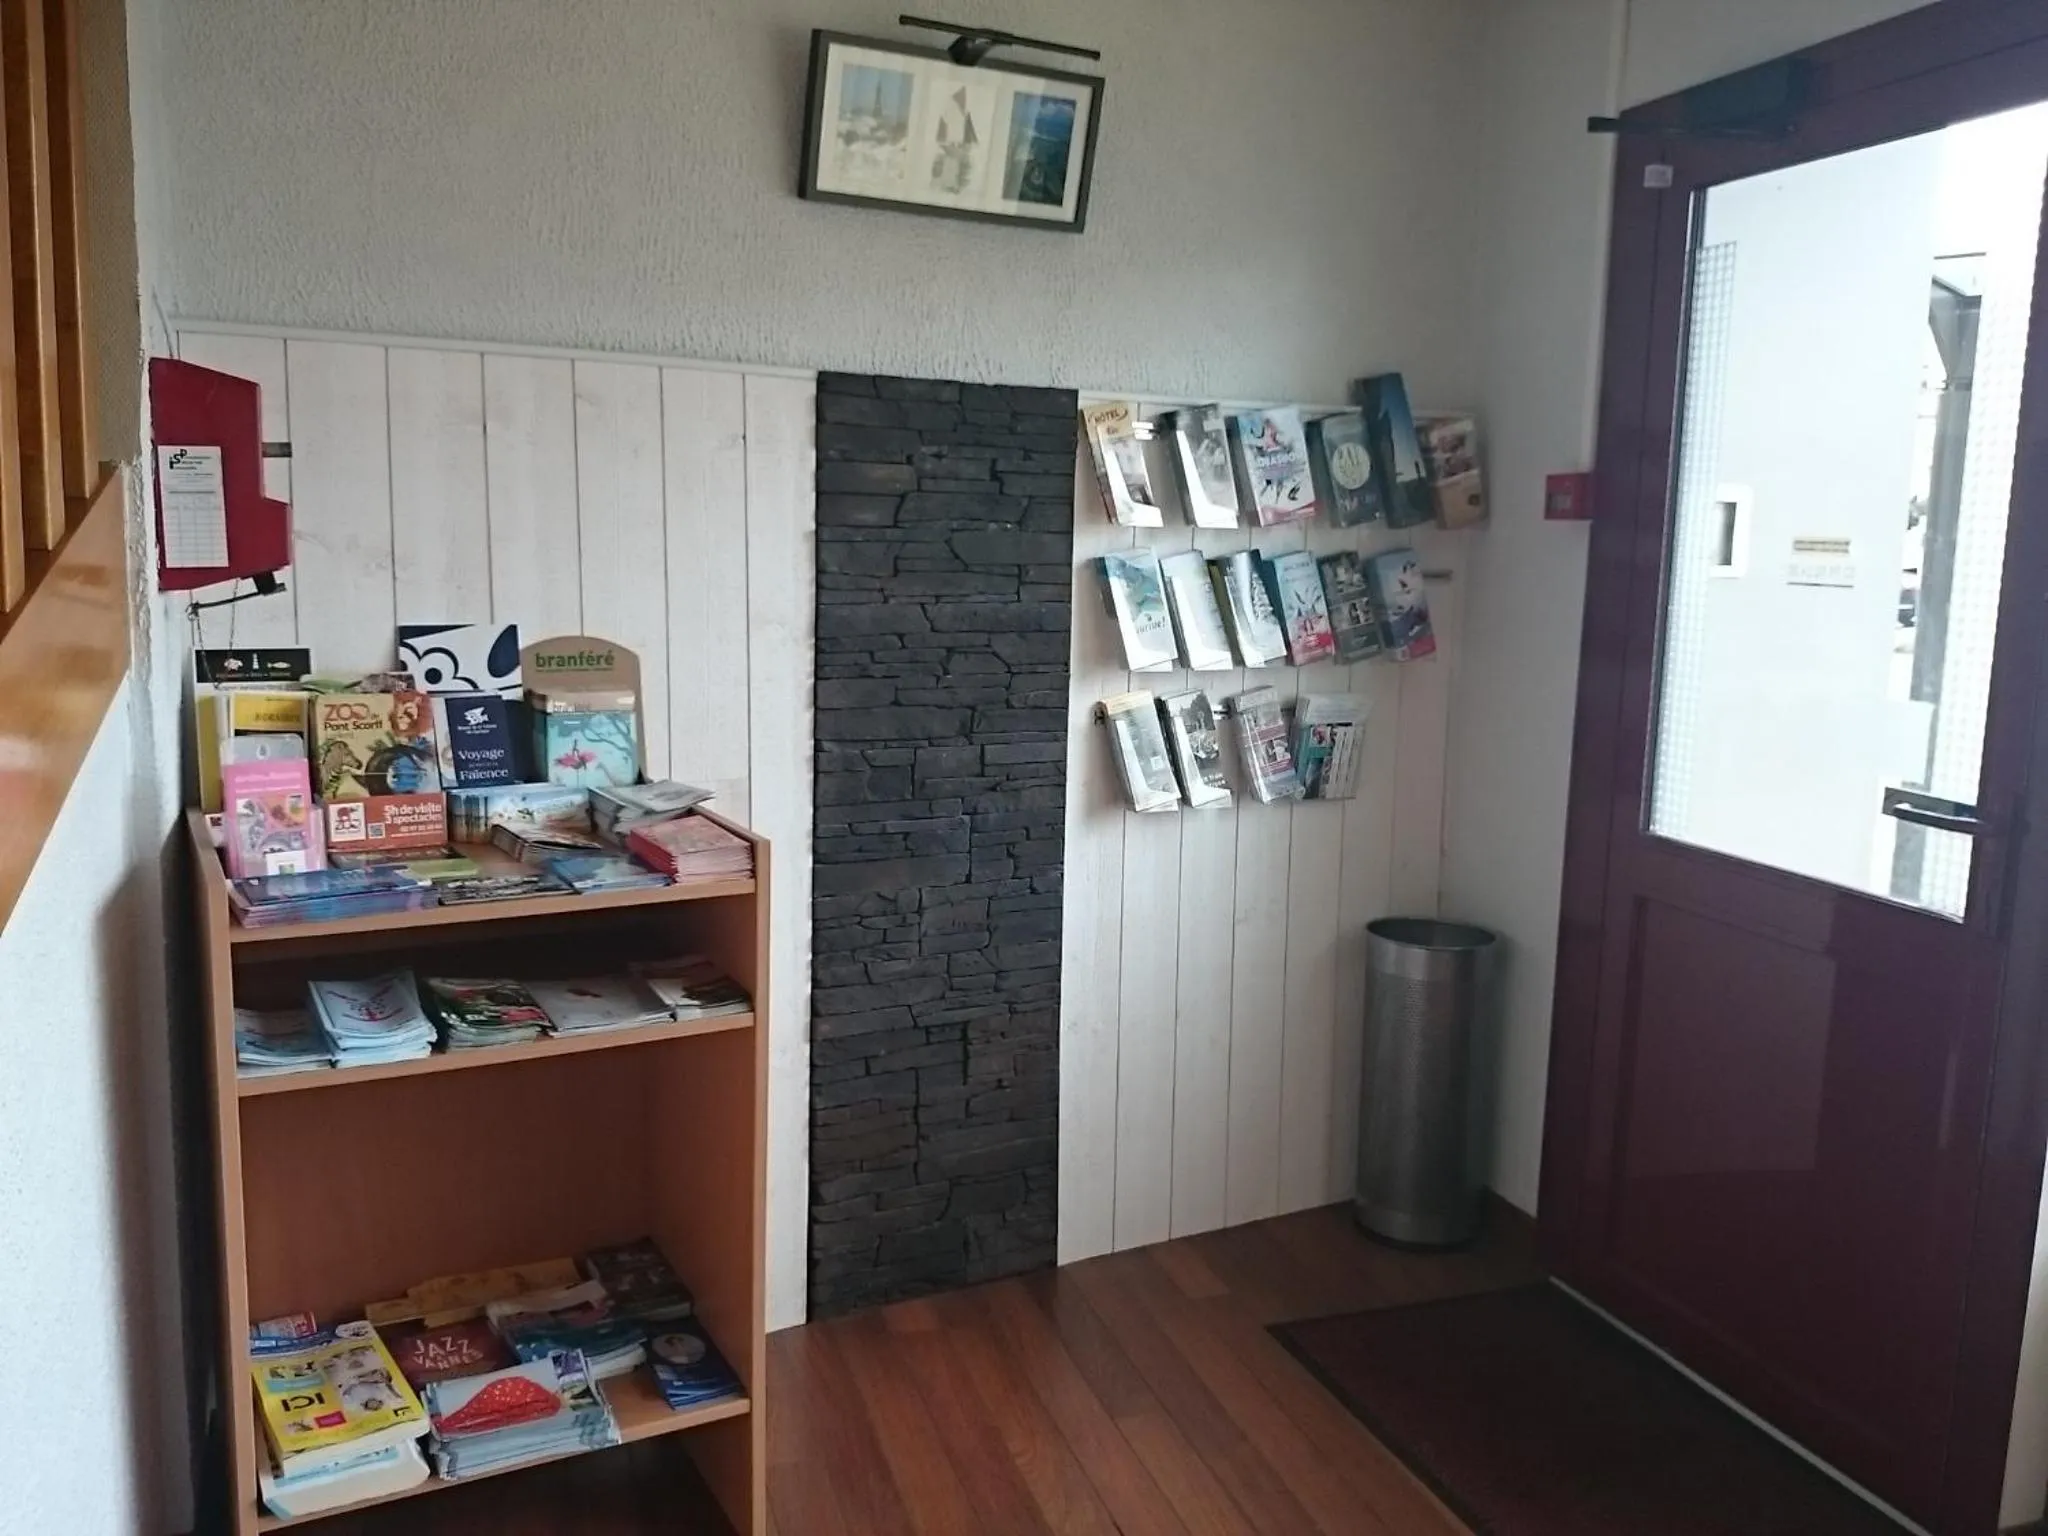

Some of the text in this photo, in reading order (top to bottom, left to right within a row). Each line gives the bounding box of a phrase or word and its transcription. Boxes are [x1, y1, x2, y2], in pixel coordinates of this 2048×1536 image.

[324, 703, 370, 721] ZOO
[324, 721, 350, 731] Pont
[458, 749, 505, 762] Voyage
[414, 1336, 471, 1358] JAZZ
